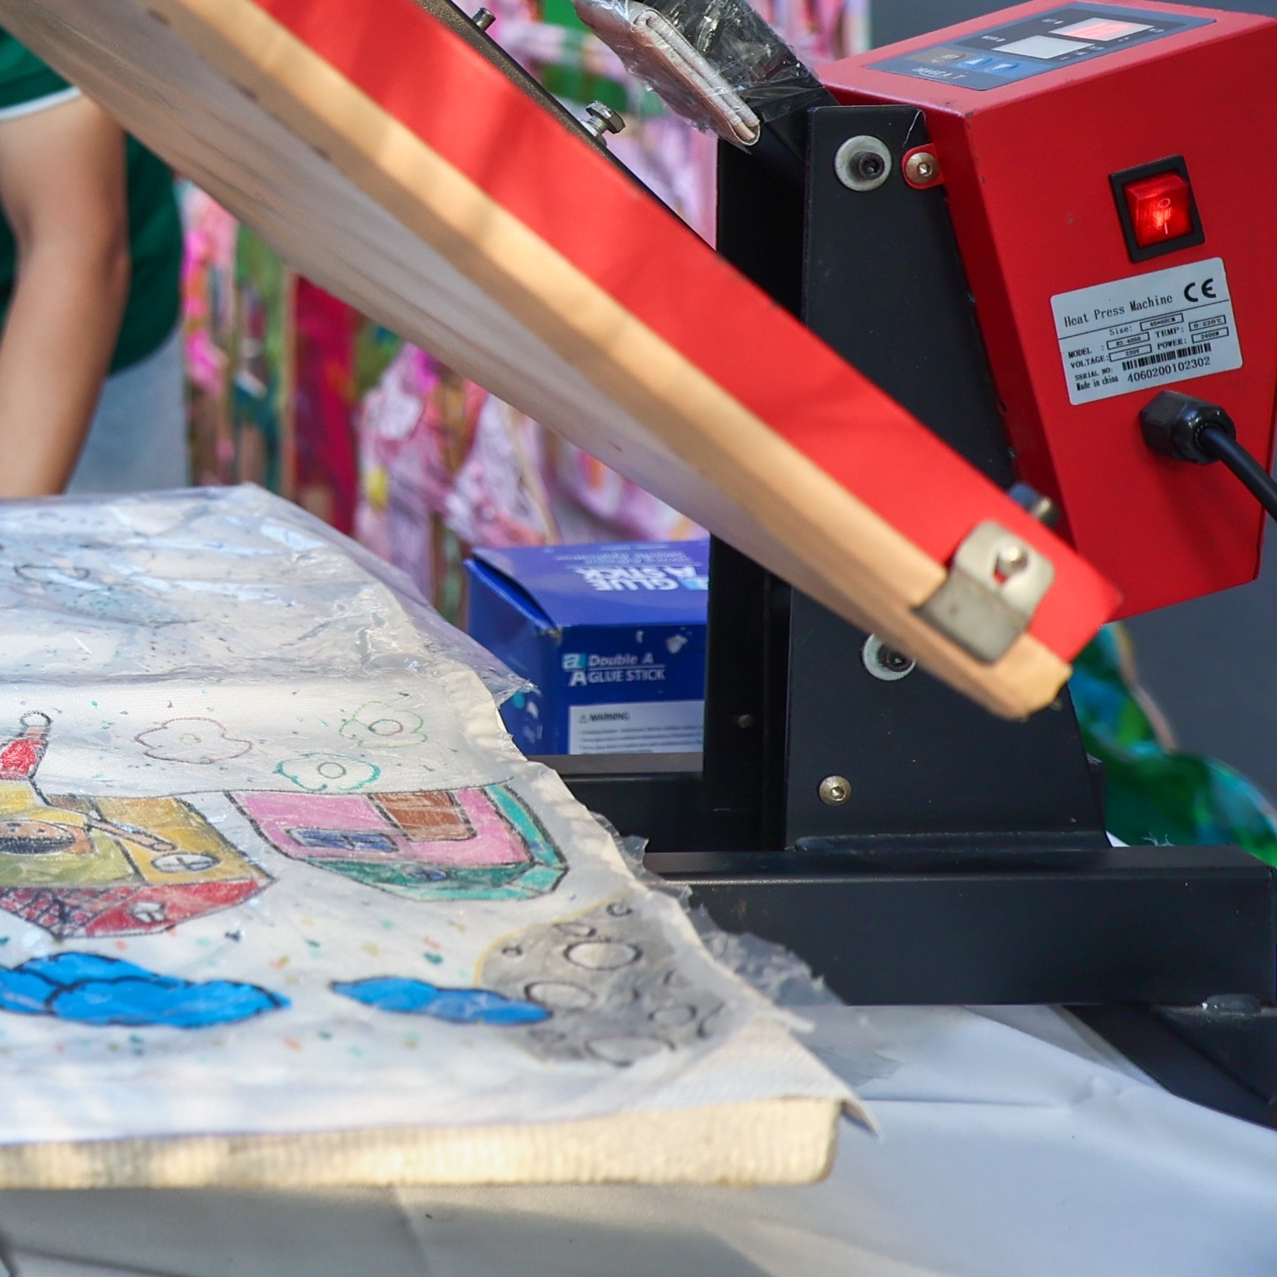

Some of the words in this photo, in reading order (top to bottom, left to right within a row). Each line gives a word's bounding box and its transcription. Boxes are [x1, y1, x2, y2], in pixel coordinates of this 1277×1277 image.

[1184, 278, 1217, 303] CE
[1063, 313, 1089, 328] Heat
[1093, 306, 1126, 321] Press
[1129, 295, 1174, 312] Machine
[1067, 346, 1093, 359] MODEL
[1074, 370, 1099, 381] SERIAL
[1076, 381, 1091, 391] Made
[1093, 378, 1101, 388] in
[588, 653, 638, 667] Double
[642, 652, 655, 665] A
[588, 669, 625, 683] GLUE
[626, 668, 666, 681] STICK
[589, 712, 631, 722] WARNING
